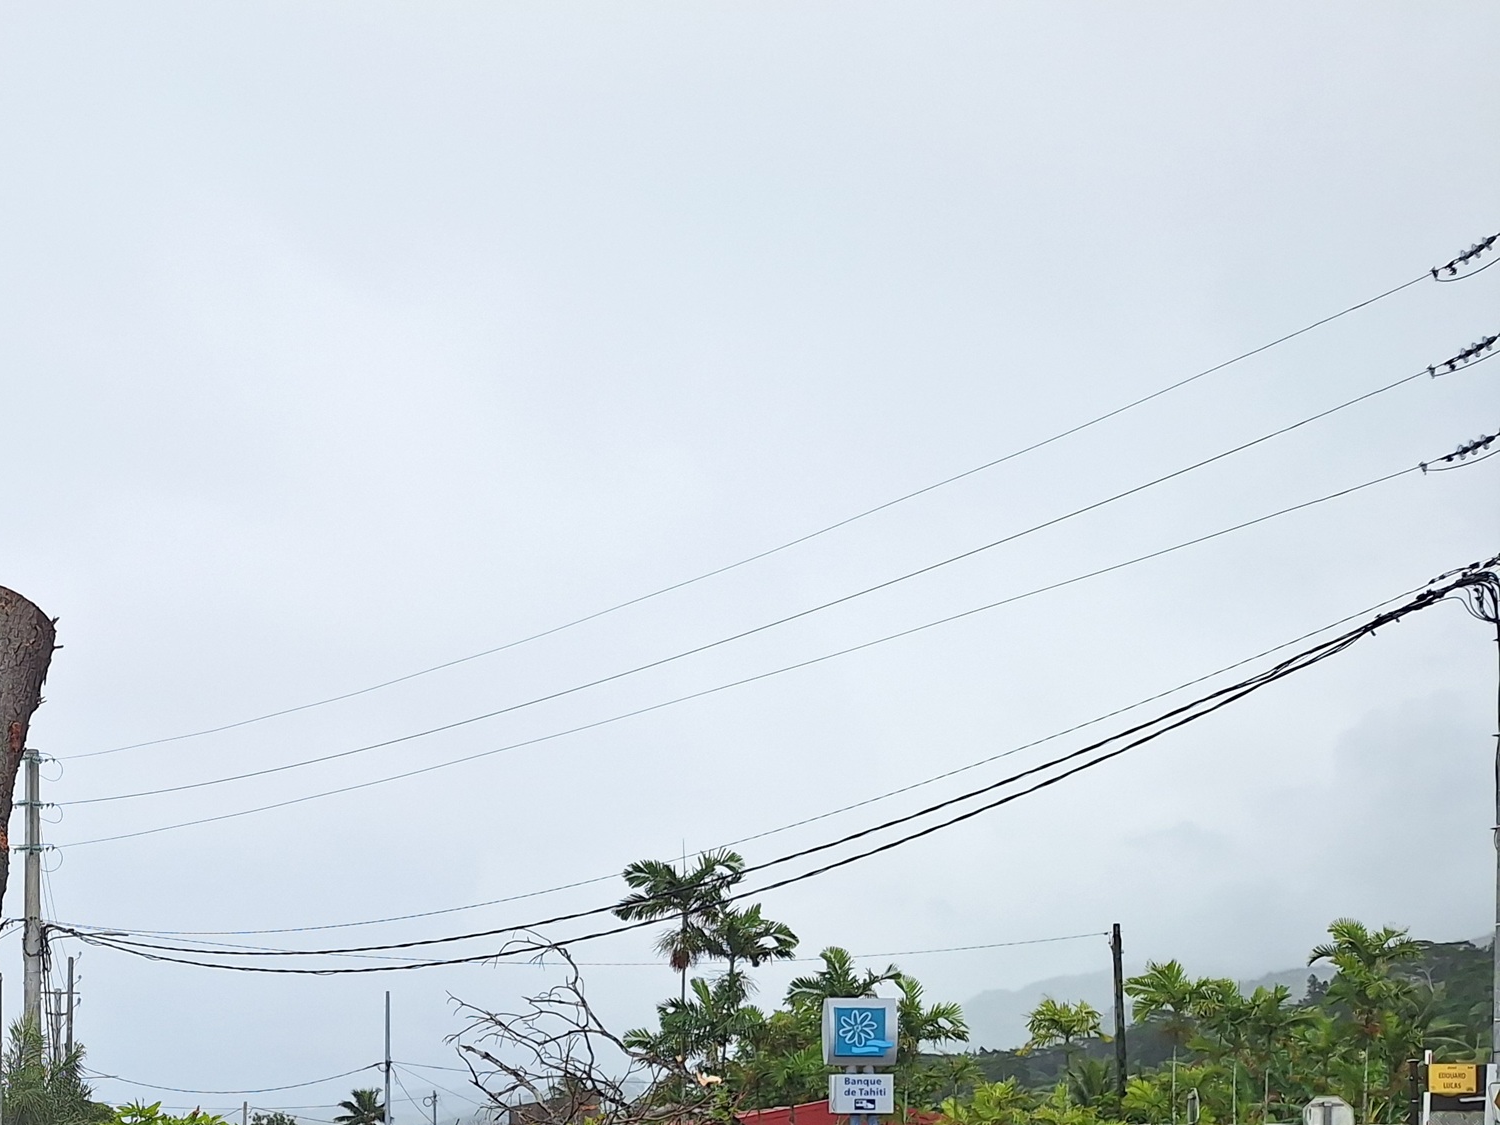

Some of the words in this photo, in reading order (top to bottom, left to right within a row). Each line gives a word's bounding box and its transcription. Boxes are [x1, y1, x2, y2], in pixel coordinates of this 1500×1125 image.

[844, 1077, 882, 1087] Banque
[844, 1088, 857, 1096] de
[859, 1088, 886, 1096] Tahiti
